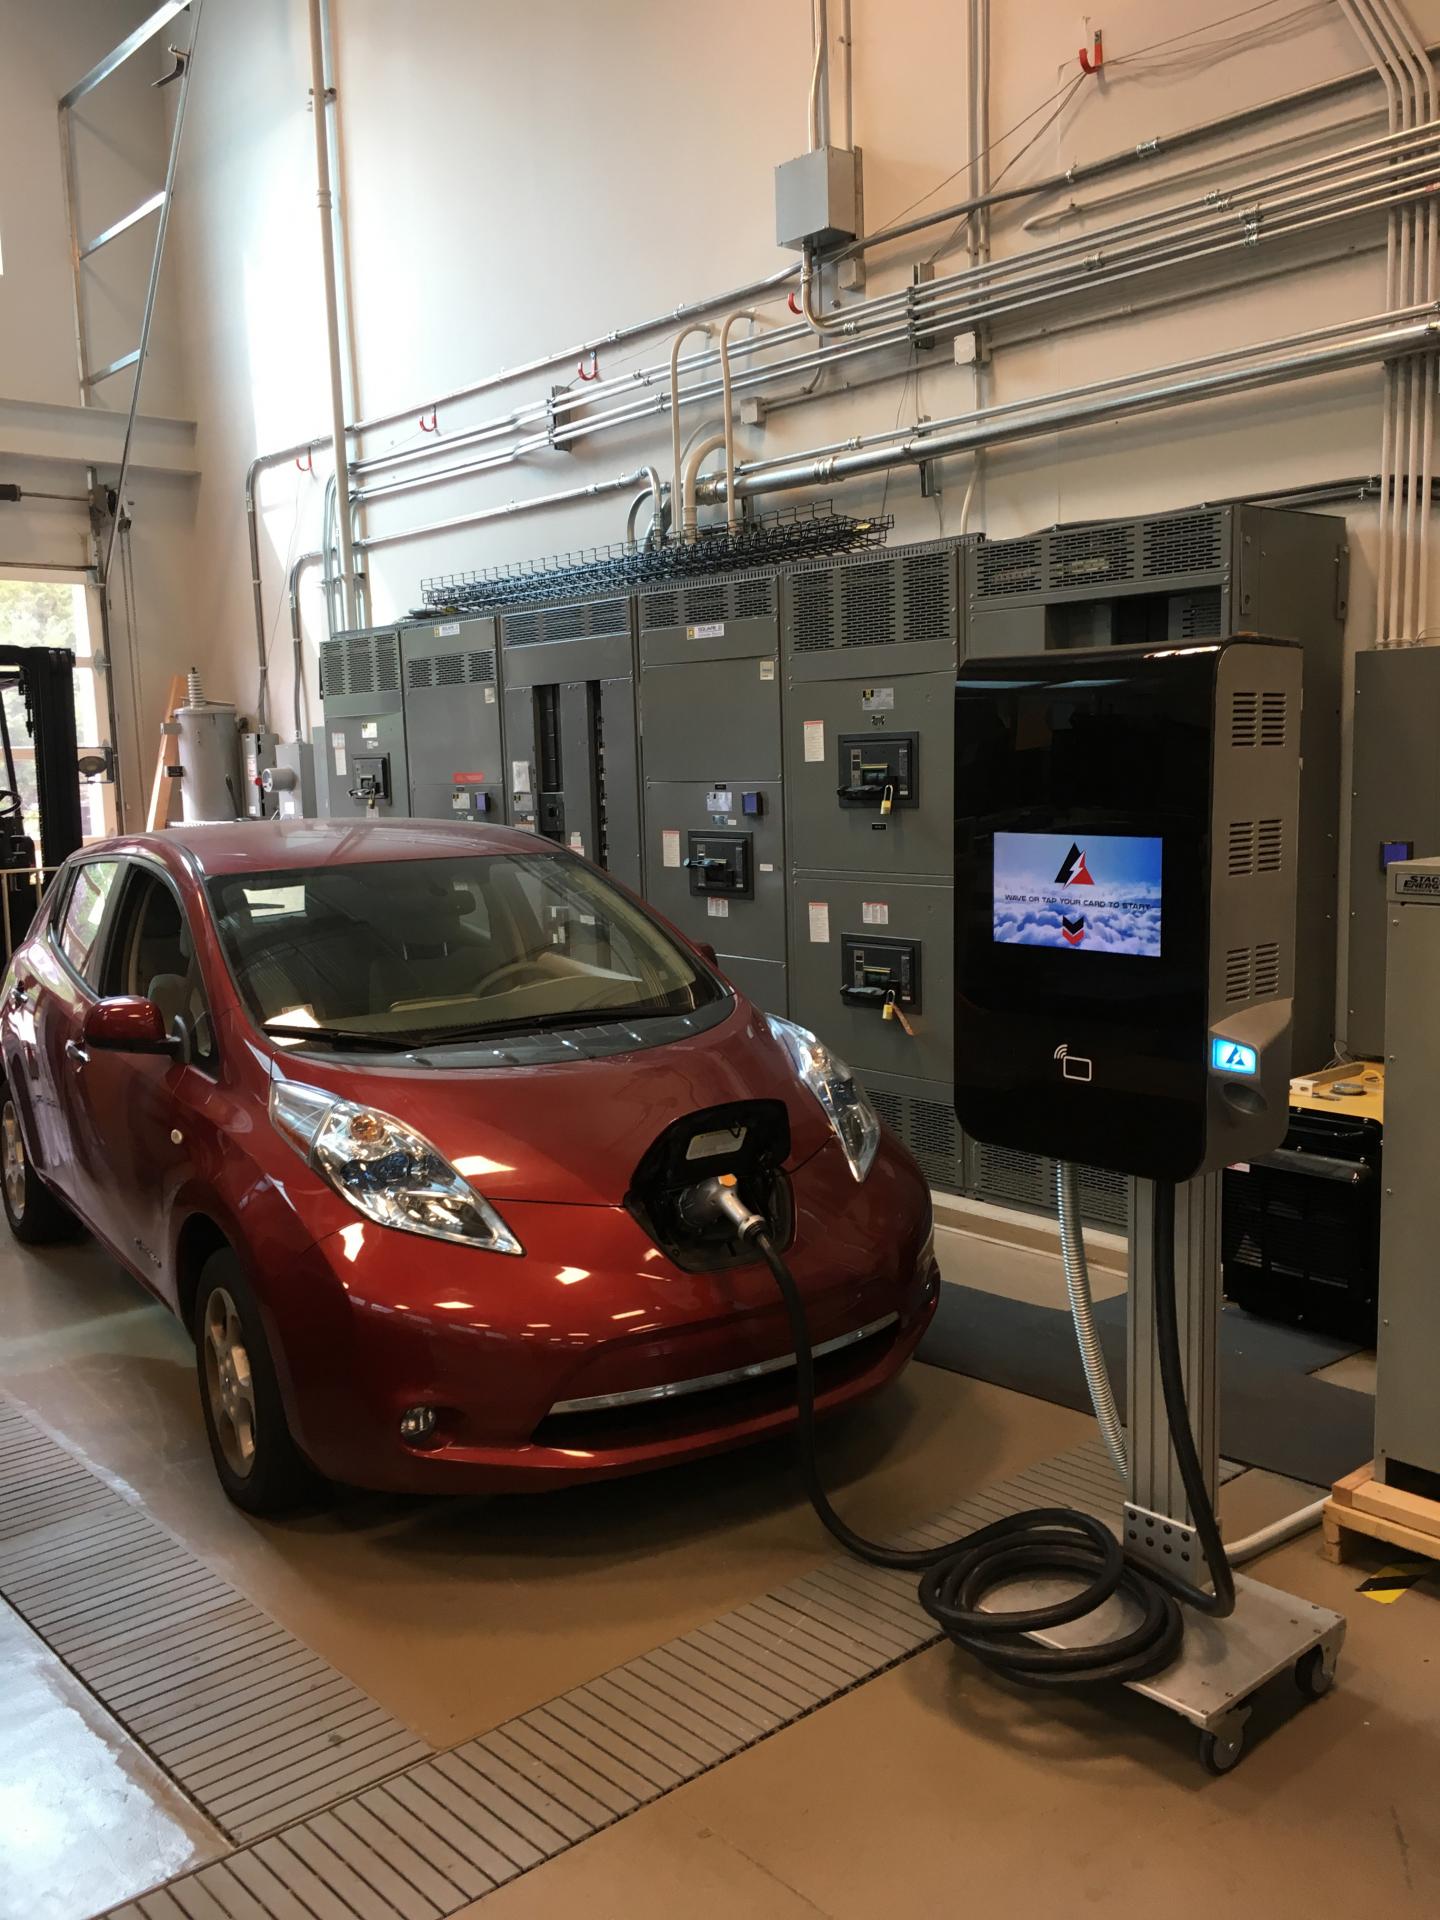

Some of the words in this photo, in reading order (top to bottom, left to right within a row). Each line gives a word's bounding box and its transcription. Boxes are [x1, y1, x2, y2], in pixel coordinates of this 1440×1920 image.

[1404, 880, 1440, 889] ENERG
[1005, 894, 1026, 902] WAVE
[1029, 895, 1040, 903] OR
[1042, 896, 1057, 904] TAP
[1060, 897, 1081, 906] YOUR
[1083, 899, 1105, 908] CARD
